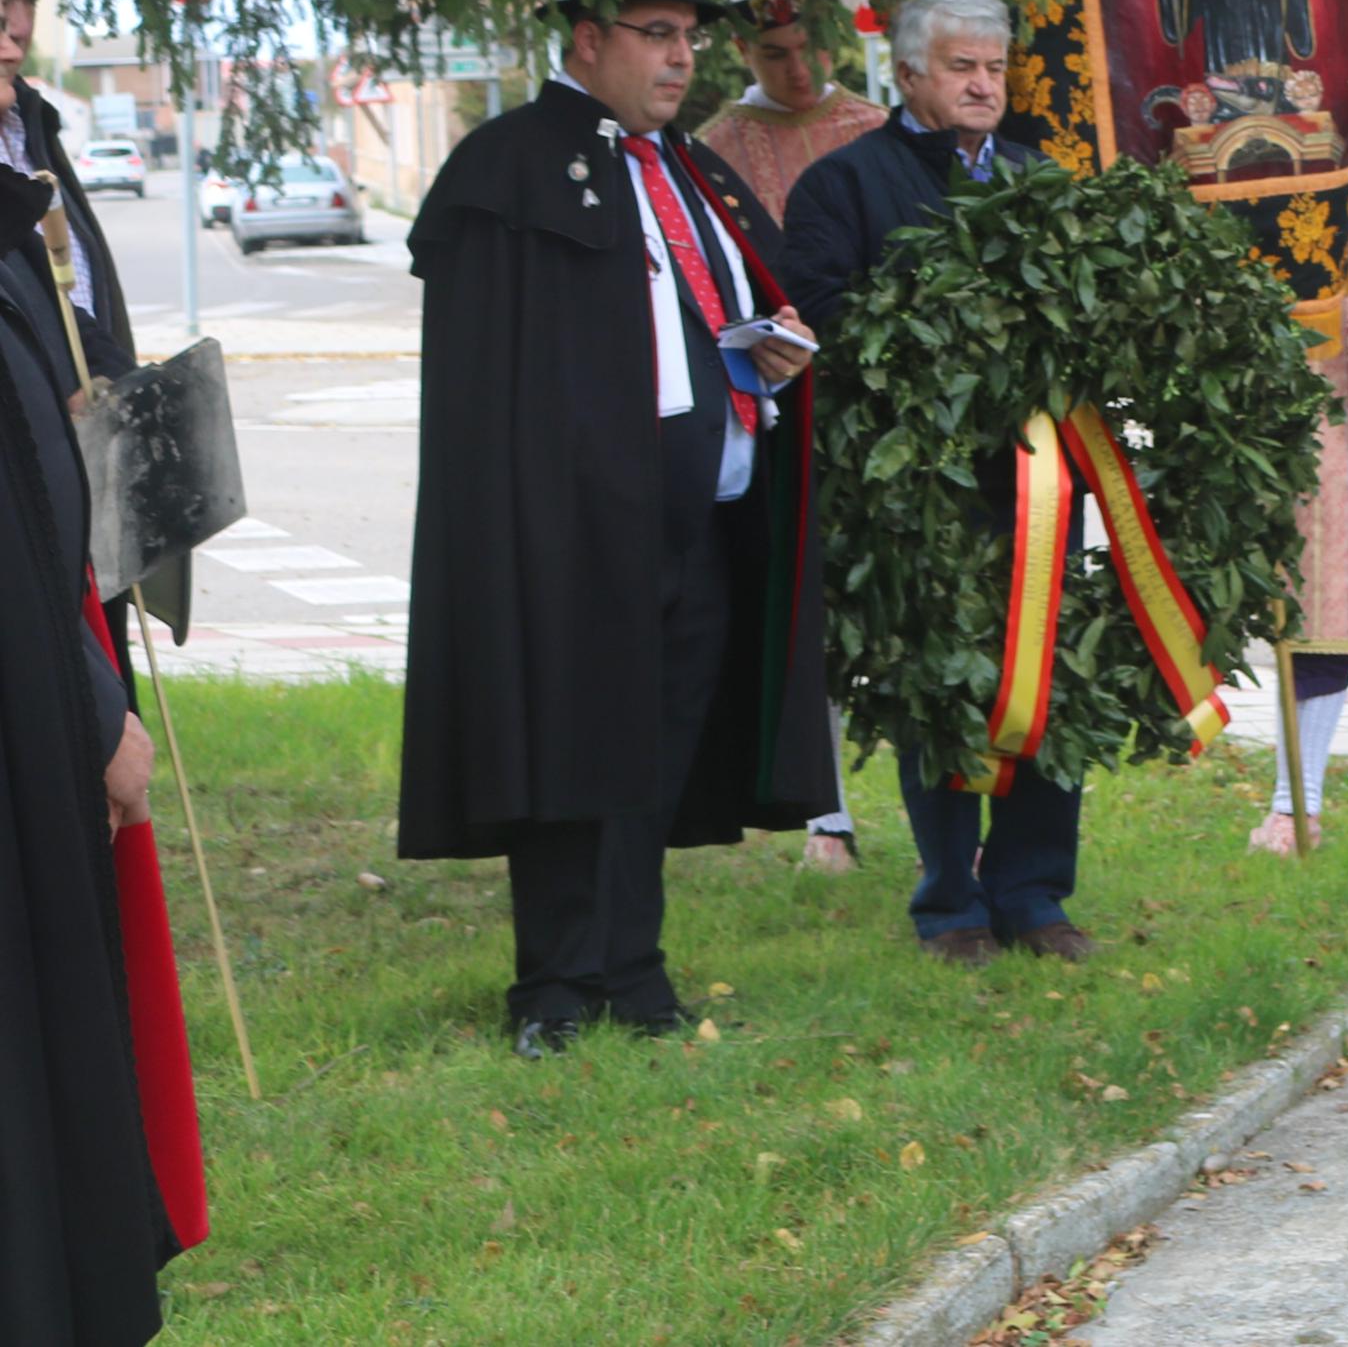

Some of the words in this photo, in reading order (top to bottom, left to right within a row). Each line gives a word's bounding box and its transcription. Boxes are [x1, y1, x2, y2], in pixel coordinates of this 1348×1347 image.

[1025, 497, 1044, 600] HOMENAJE
[1094, 429, 1150, 559] COOPERATIVA
[1142, 560, 1167, 595] DEL
